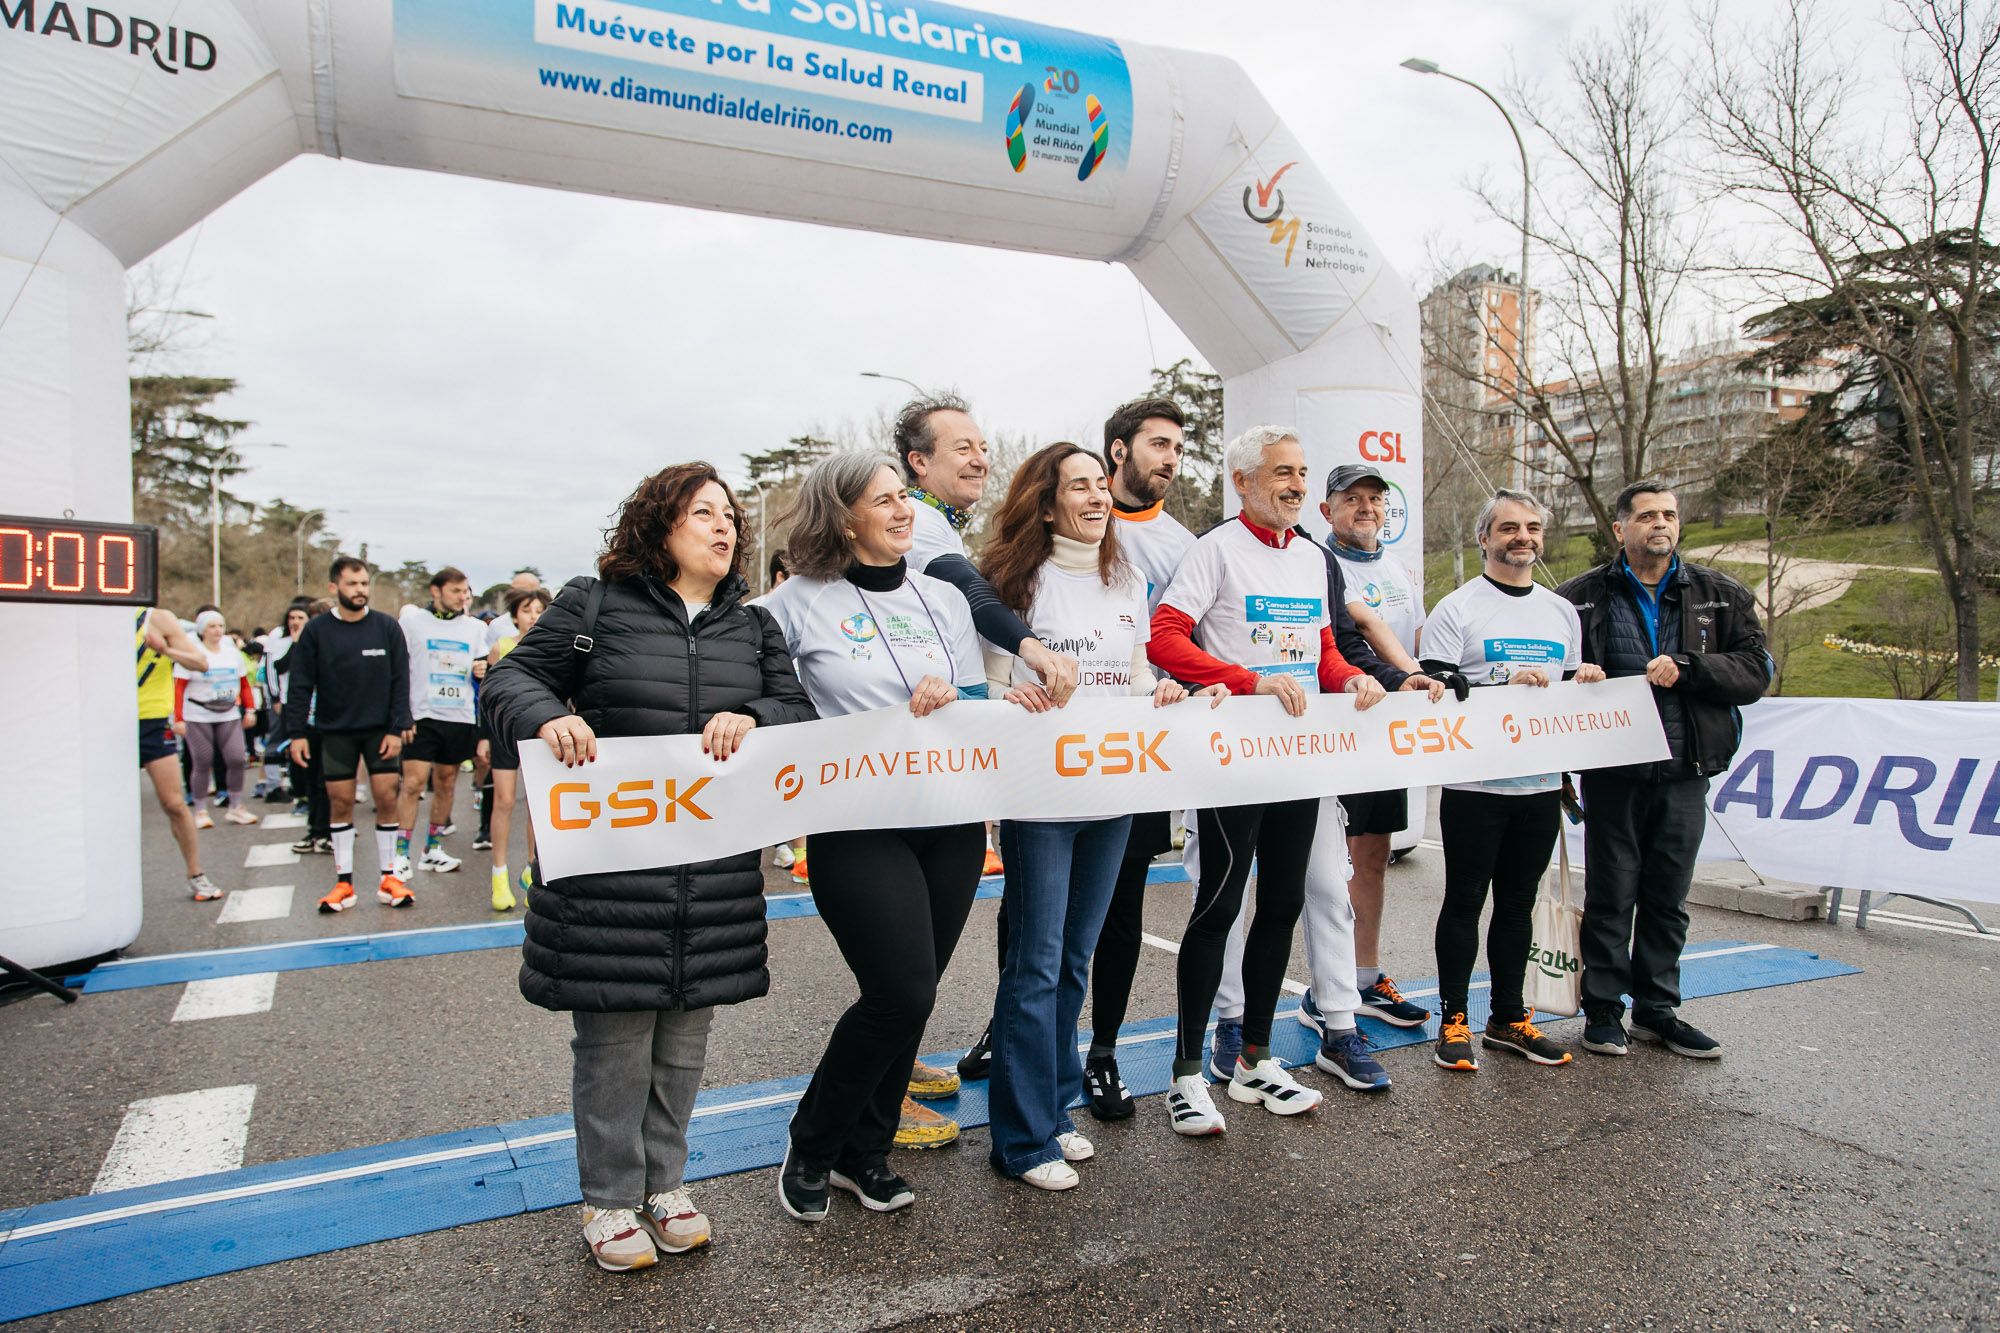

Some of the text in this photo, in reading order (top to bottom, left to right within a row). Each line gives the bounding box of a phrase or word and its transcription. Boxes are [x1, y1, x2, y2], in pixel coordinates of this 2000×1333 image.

[0, 0, 217, 75] MADRID
[789, 0, 1023, 65] Solidaria
[556, 3, 696, 54] Muévete
[706, 40, 757, 65] por
[767, 43, 793, 72] la
[803, 52, 883, 89] Salud
[893, 68, 967, 104] Renal
[538, 67, 893, 144] www.diamundialdelriñon.com
[1035, 118, 1080, 135] Mundial
[1033, 135, 1051, 147] del
[1041, 153, 1062, 163] marzo
[1306, 222, 1352, 240] Sociedad
[1306, 240, 1355, 257] Española
[1358, 430, 1407, 464] CSL
[1384, 508, 1405, 518] YER
[1082, 659, 1103, 668] hacer
[1104, 660, 1121, 669] algo
[438, 687, 460, 698] 401
[549, 709, 1632, 831] GSK DIAVERUM GSK DIAVERUM GSK DIAVERUM
[1713, 749, 2000, 851] ADRI
